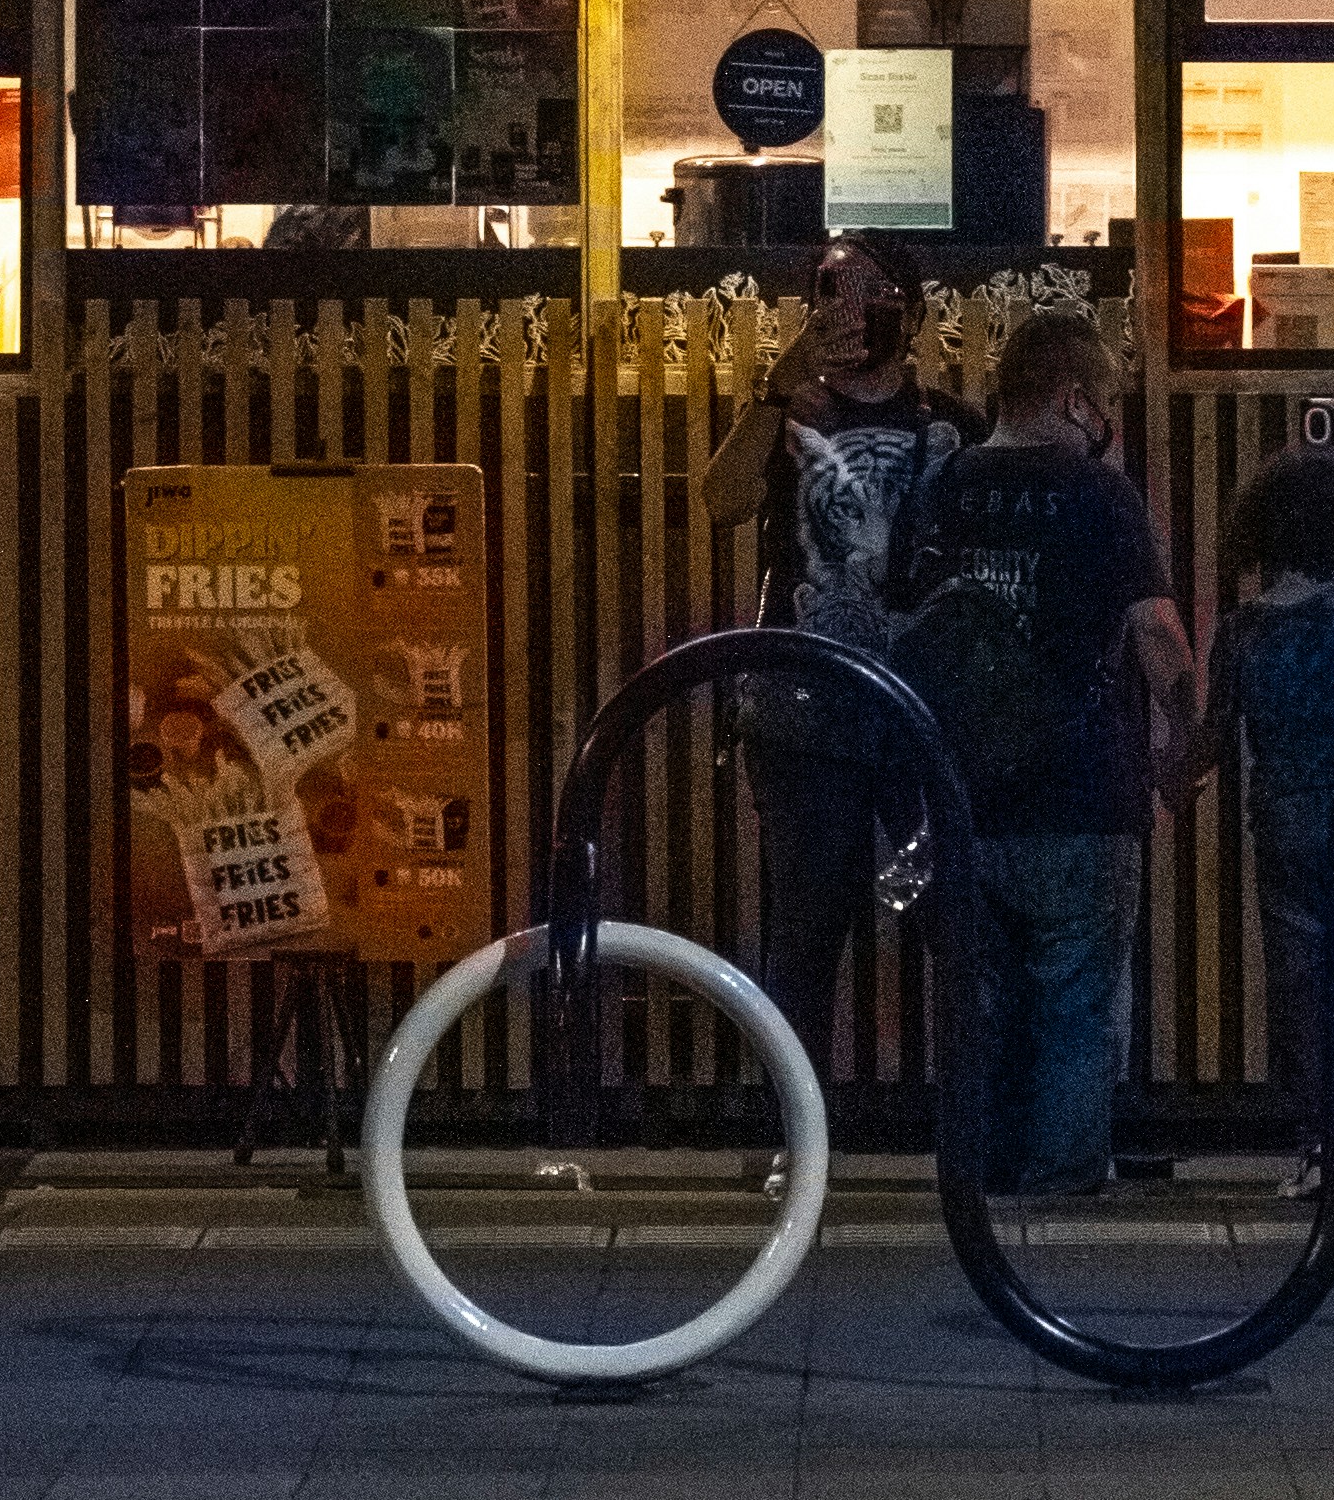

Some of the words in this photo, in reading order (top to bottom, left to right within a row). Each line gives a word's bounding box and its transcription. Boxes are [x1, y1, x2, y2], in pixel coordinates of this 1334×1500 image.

[742, 77, 803, 98] OPEN
[146, 564, 303, 610] FRIES
[241, 656, 305, 700] FRIES
[281, 705, 349, 755] FRIES
[203, 817, 282, 853] FRIES
[219, 891, 303, 932] FRIES
